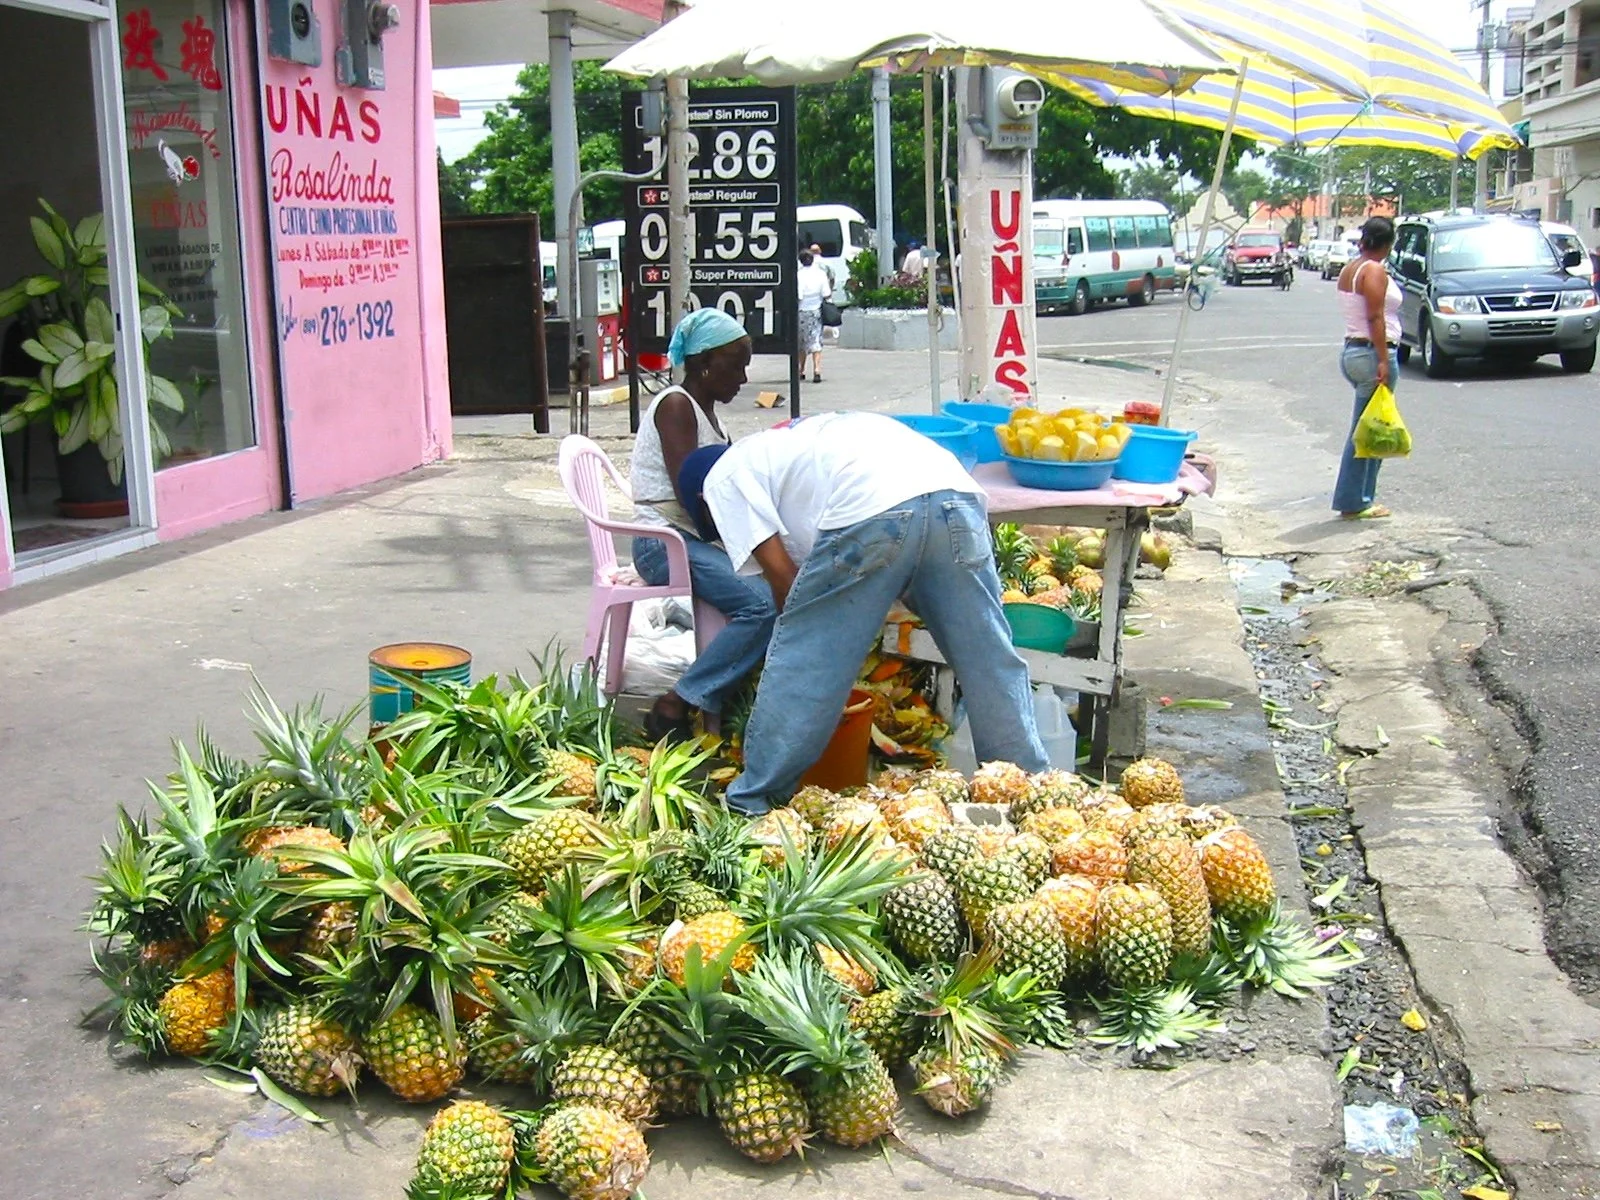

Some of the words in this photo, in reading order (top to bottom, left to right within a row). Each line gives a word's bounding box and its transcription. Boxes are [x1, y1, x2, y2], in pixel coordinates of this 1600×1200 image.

[265, 77, 381, 144] UÑAS
[714, 109, 732, 120] Sin
[734, 109, 769, 120] Plomo
[271, 148, 395, 204] Rosalinda
[716, 190, 758, 202] Regular
[694, 270, 725, 281] Super
[727, 269, 774, 280] Premium
[990, 190, 1030, 397] UÑAS
[321, 300, 395, 346] 276-1392
